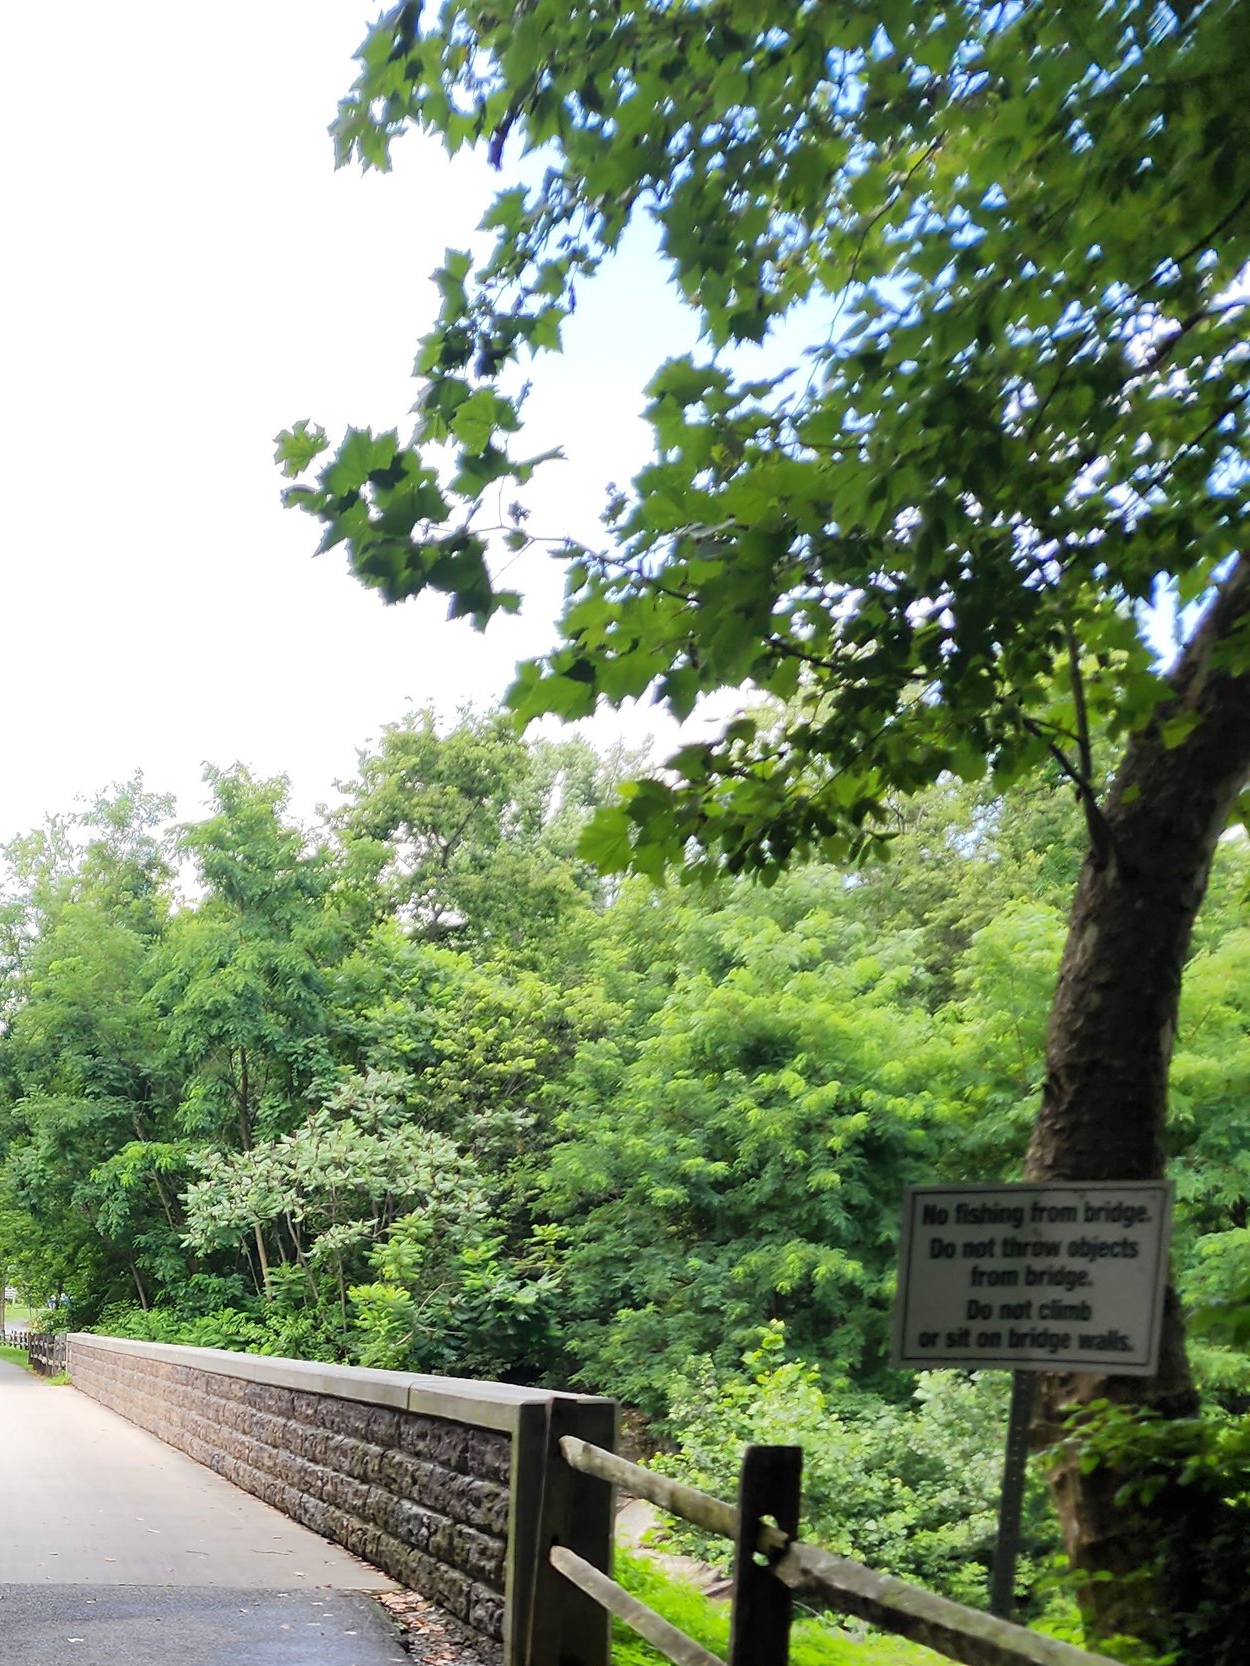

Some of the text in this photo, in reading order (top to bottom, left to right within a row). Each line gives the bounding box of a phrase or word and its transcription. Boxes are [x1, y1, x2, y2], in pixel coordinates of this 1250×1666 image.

[922, 1202, 1152, 1228] No fishing from bridge.
[930, 1237, 1139, 1262] Do not throw objects
[971, 1266, 1092, 1291] from bridge.
[966, 1300, 992, 1320] Do
[1000, 1302, 1032, 1320] not
[918, 1331, 939, 1348] or
[946, 1328, 970, 1348] sit
[977, 1331, 1001, 1348] on
[1008, 1328, 1071, 1354] bridge
